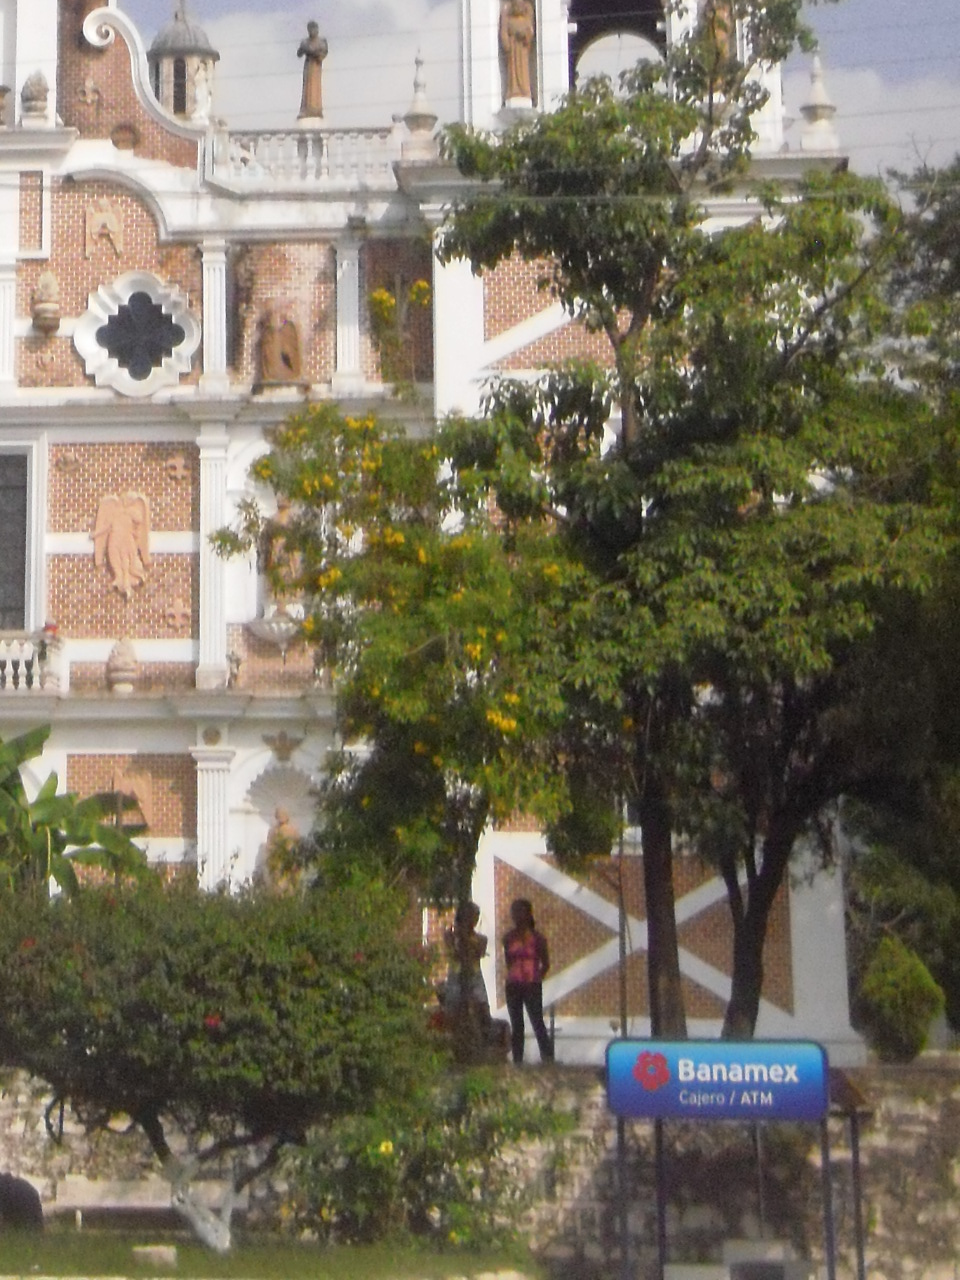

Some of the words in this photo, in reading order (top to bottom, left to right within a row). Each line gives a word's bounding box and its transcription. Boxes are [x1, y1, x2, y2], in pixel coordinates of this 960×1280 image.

[678, 1059, 798, 1082] Banamex
[679, 1090, 725, 1106] Cajero
[740, 1091, 773, 1105] ATM
